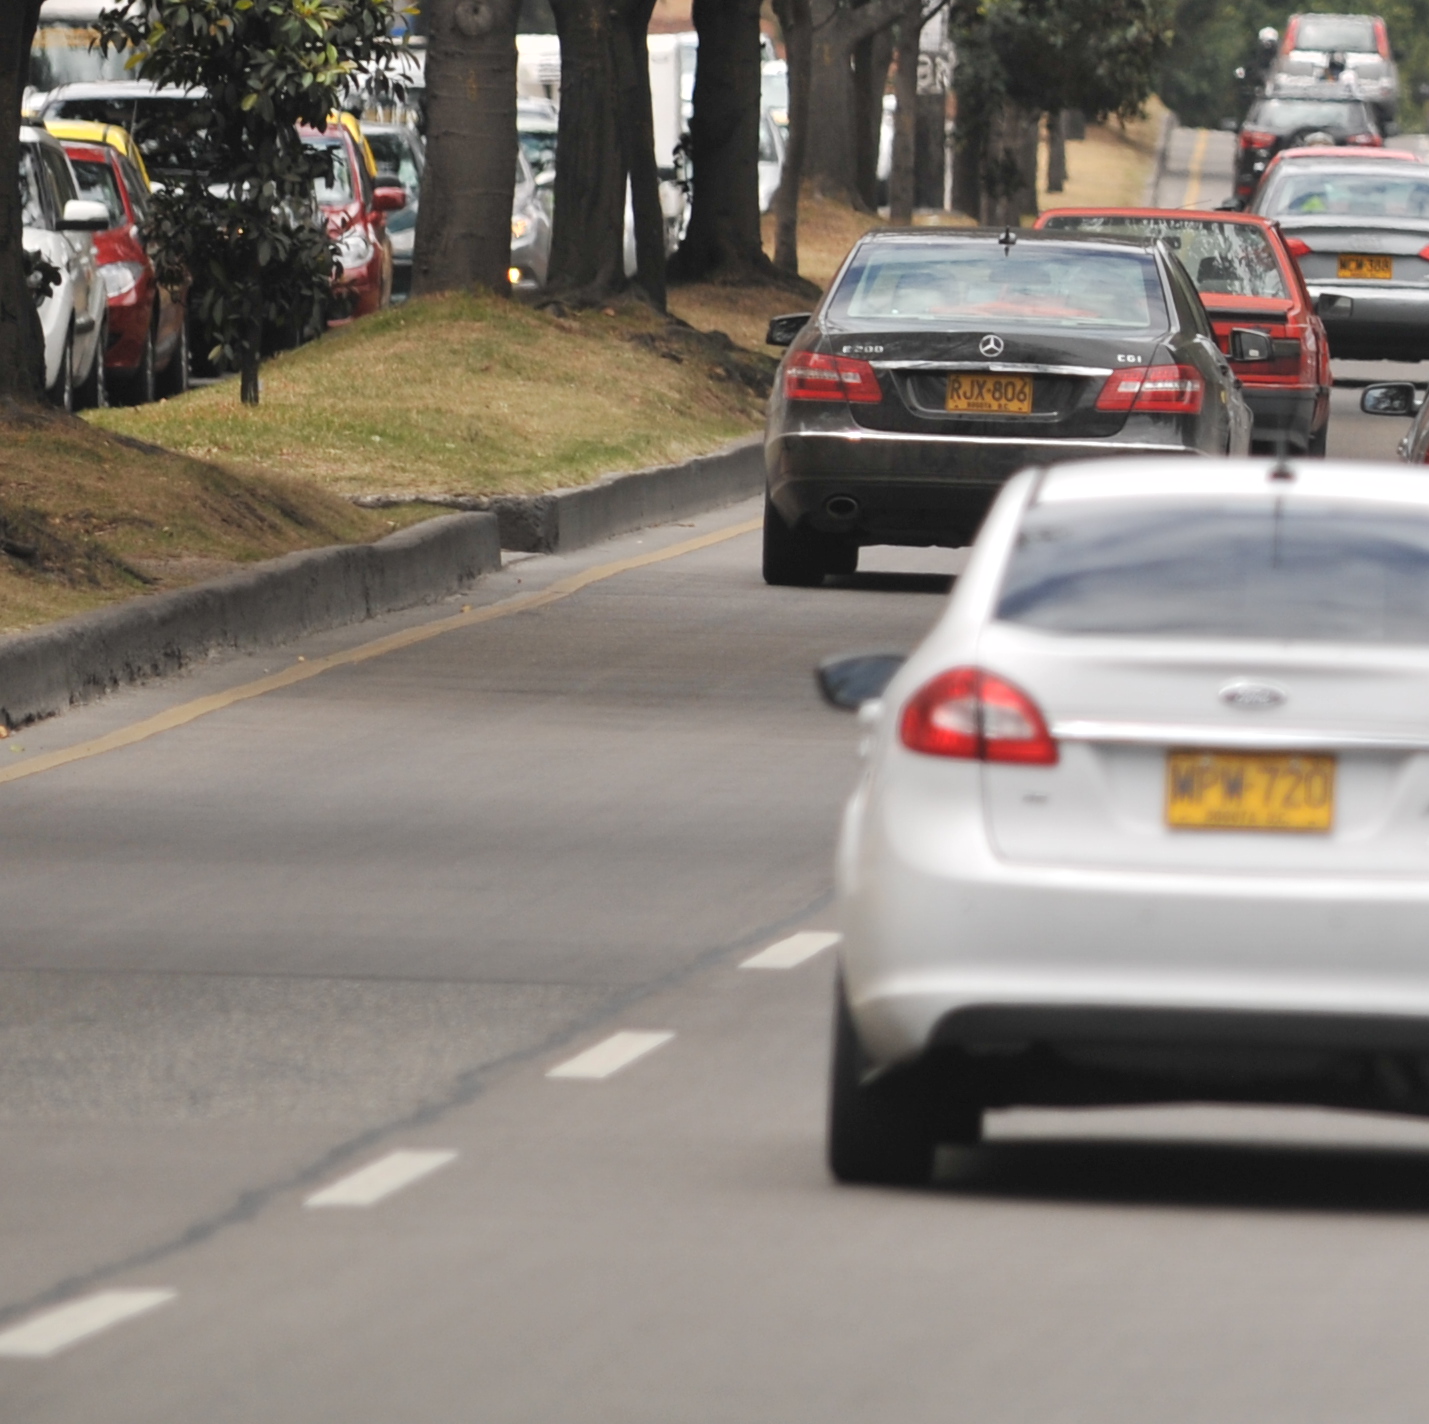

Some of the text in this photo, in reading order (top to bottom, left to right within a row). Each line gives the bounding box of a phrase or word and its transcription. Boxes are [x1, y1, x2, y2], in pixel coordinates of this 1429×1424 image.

[1116, 353, 1143, 364] CGI
[949, 380, 1029, 404] RJX-806
[1170, 762, 1330, 810] MPW-720
